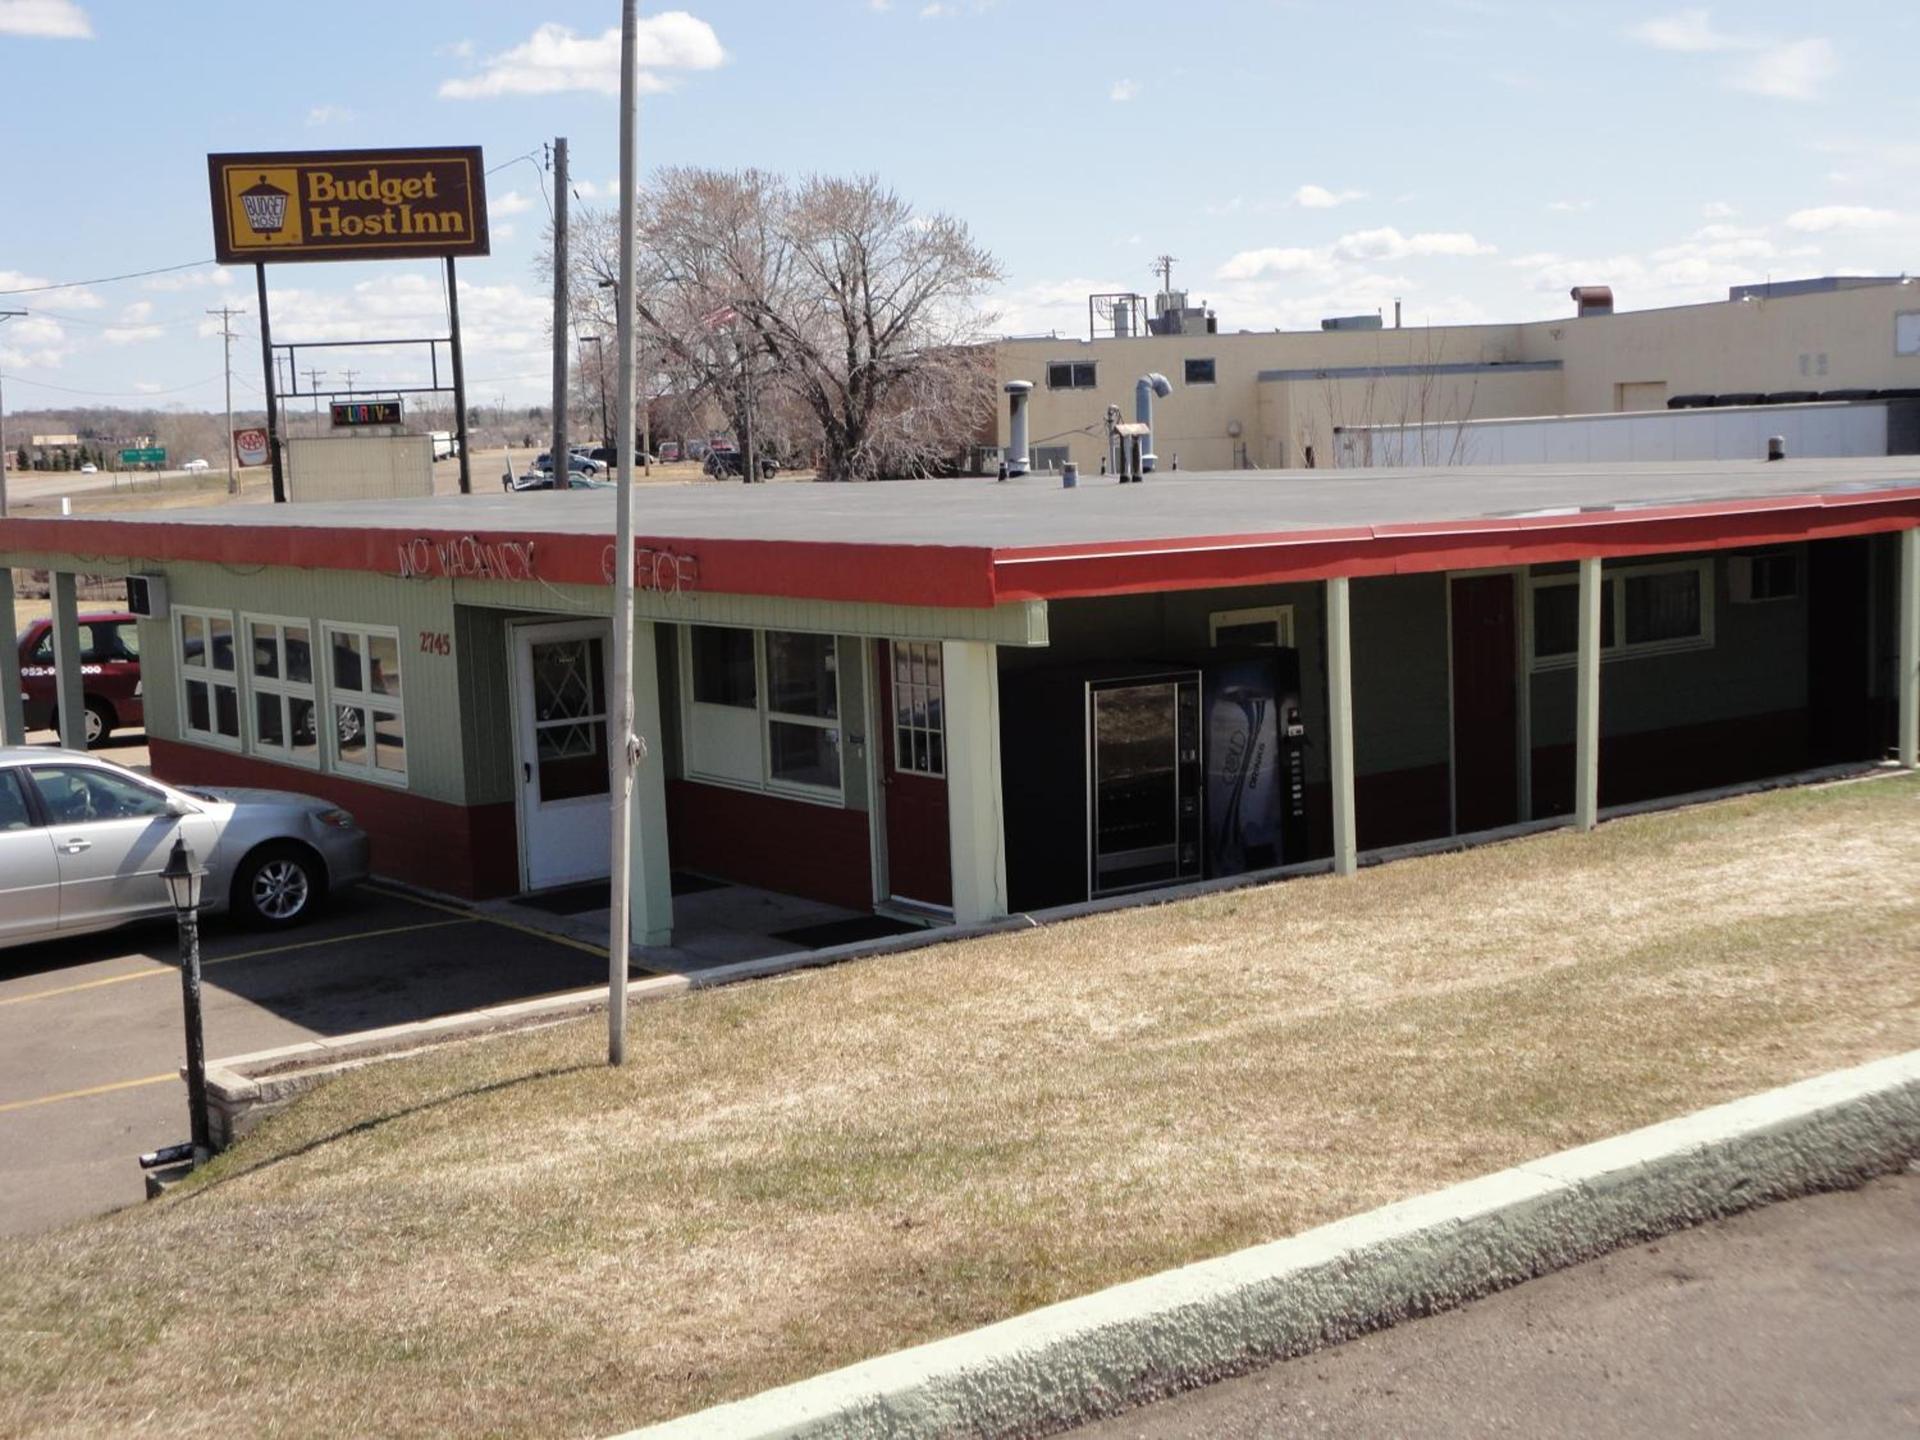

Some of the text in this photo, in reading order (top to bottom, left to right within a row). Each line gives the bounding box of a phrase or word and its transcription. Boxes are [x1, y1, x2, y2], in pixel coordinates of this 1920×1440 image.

[306, 169, 437, 205] Budget
[246, 197, 284, 215] BUDGET
[251, 215, 281, 227] HOST
[309, 204, 464, 237] Host Inn
[400, 535, 535, 583] NO VACANCY
[601, 543, 697, 595] OFICE
[419, 631, 451, 656] 2745
